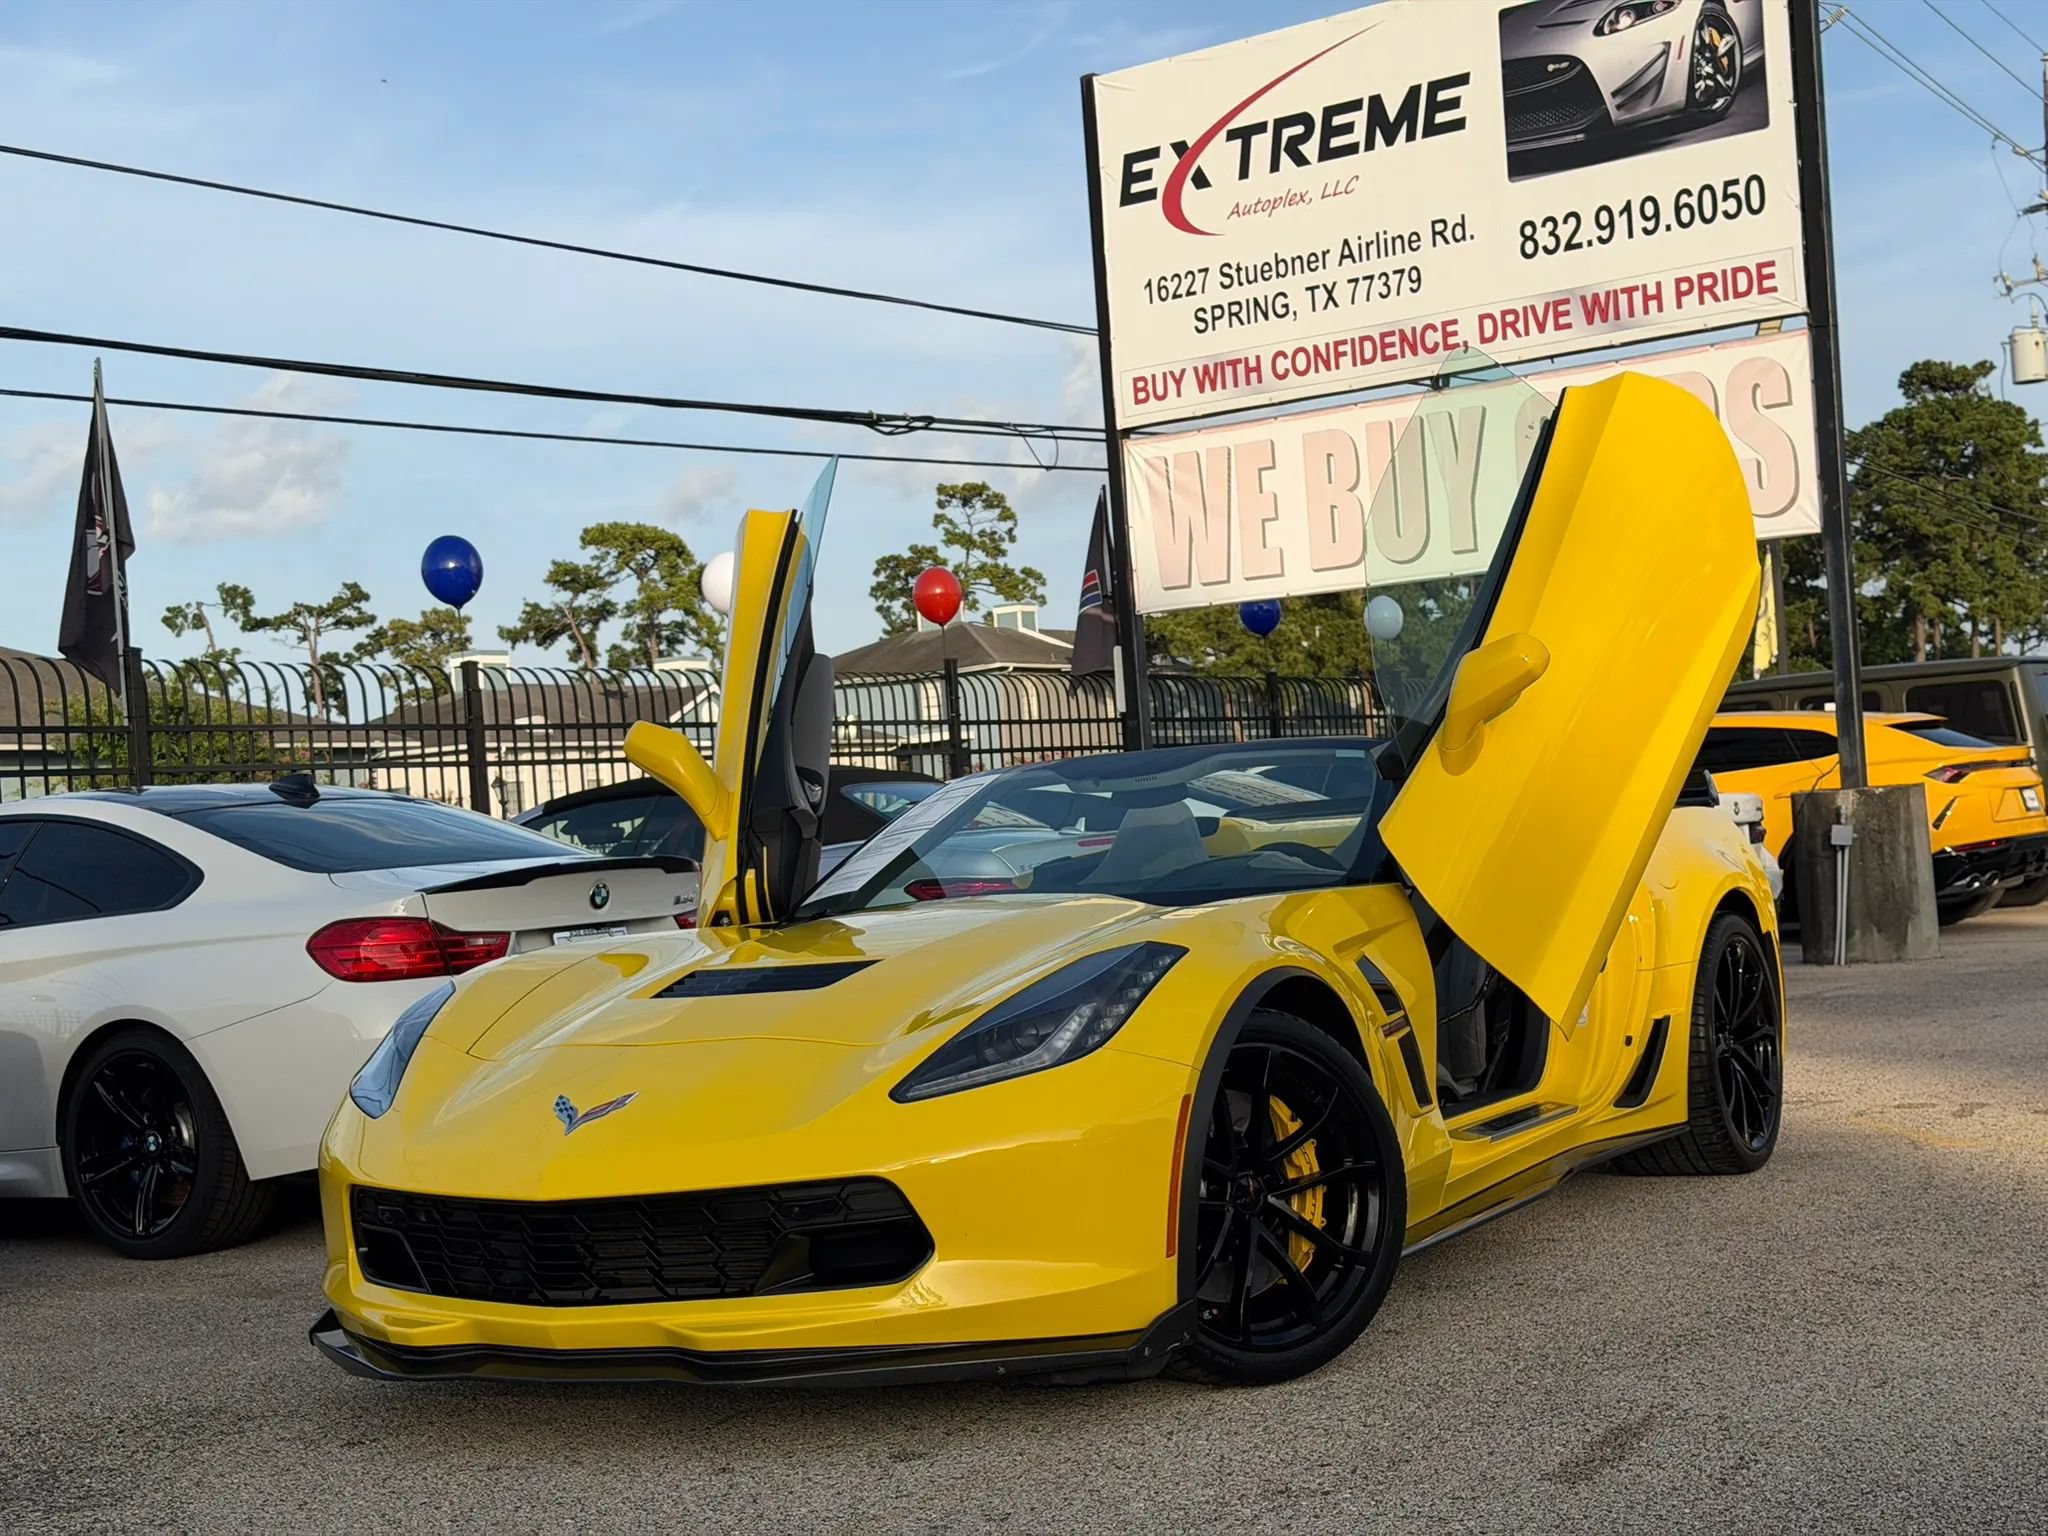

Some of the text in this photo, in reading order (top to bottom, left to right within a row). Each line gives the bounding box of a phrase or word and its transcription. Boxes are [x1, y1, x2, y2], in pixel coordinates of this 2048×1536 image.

[1119, 71, 1471, 208] EXTREME
[1226, 175, 1360, 220] Autoplex, LLC
[1519, 174, 1767, 260] 832.919.6050
[1143, 213, 1475, 305] 16227 Stuebner Airline Rd.
[1194, 265, 1422, 334] SPRING, TX 77379
[1133, 260, 1777, 405] BUY WITH CONFIDENCE, DRIVE WITH PRIDE
[1150, 437, 1284, 591] WE
[1301, 404, 1487, 572] BUY
